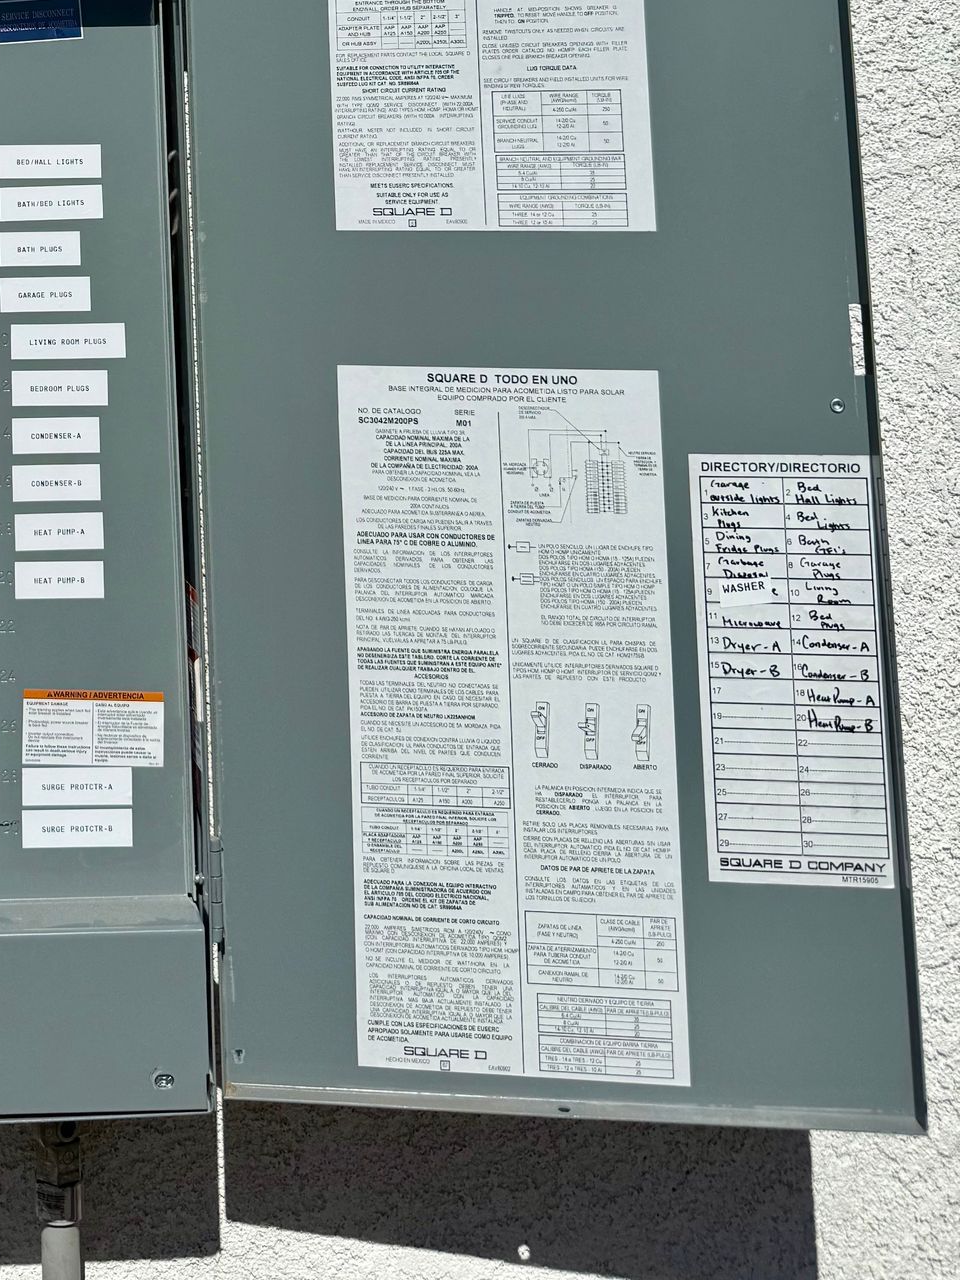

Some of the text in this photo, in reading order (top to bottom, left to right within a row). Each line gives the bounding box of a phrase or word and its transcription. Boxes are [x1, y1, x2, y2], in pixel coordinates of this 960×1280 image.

[372, 207, 452, 216] SQUARE D
[427, 372, 577, 385] SQUARE D TODO EN UNO
[358, 416, 418, 424] SC3042M200PS
[700, 461, 860, 473] DIRECTORY/DIRECTORIO
[31, 479, 82, 488] CONDENSER-B
[711, 480, 749, 490] Garage
[797, 482, 821, 493] Bed
[795, 494, 820, 504] Hall
[797, 511, 818, 522] Bed
[817, 518, 850, 532] Lights
[716, 531, 751, 543] Dining
[800, 557, 841, 570] Garage
[812, 569, 840, 580] Plugs
[722, 581, 765, 593] WASHER
[806, 582, 838, 596] Living
[817, 594, 851, 605] Room
[809, 610, 832, 621] Bed
[70, 825, 113, 833] PROTCTR-B
[720, 857, 886, 872] SQUARE D COMPANY
[403, 1045, 487, 1060] SQUARE D
